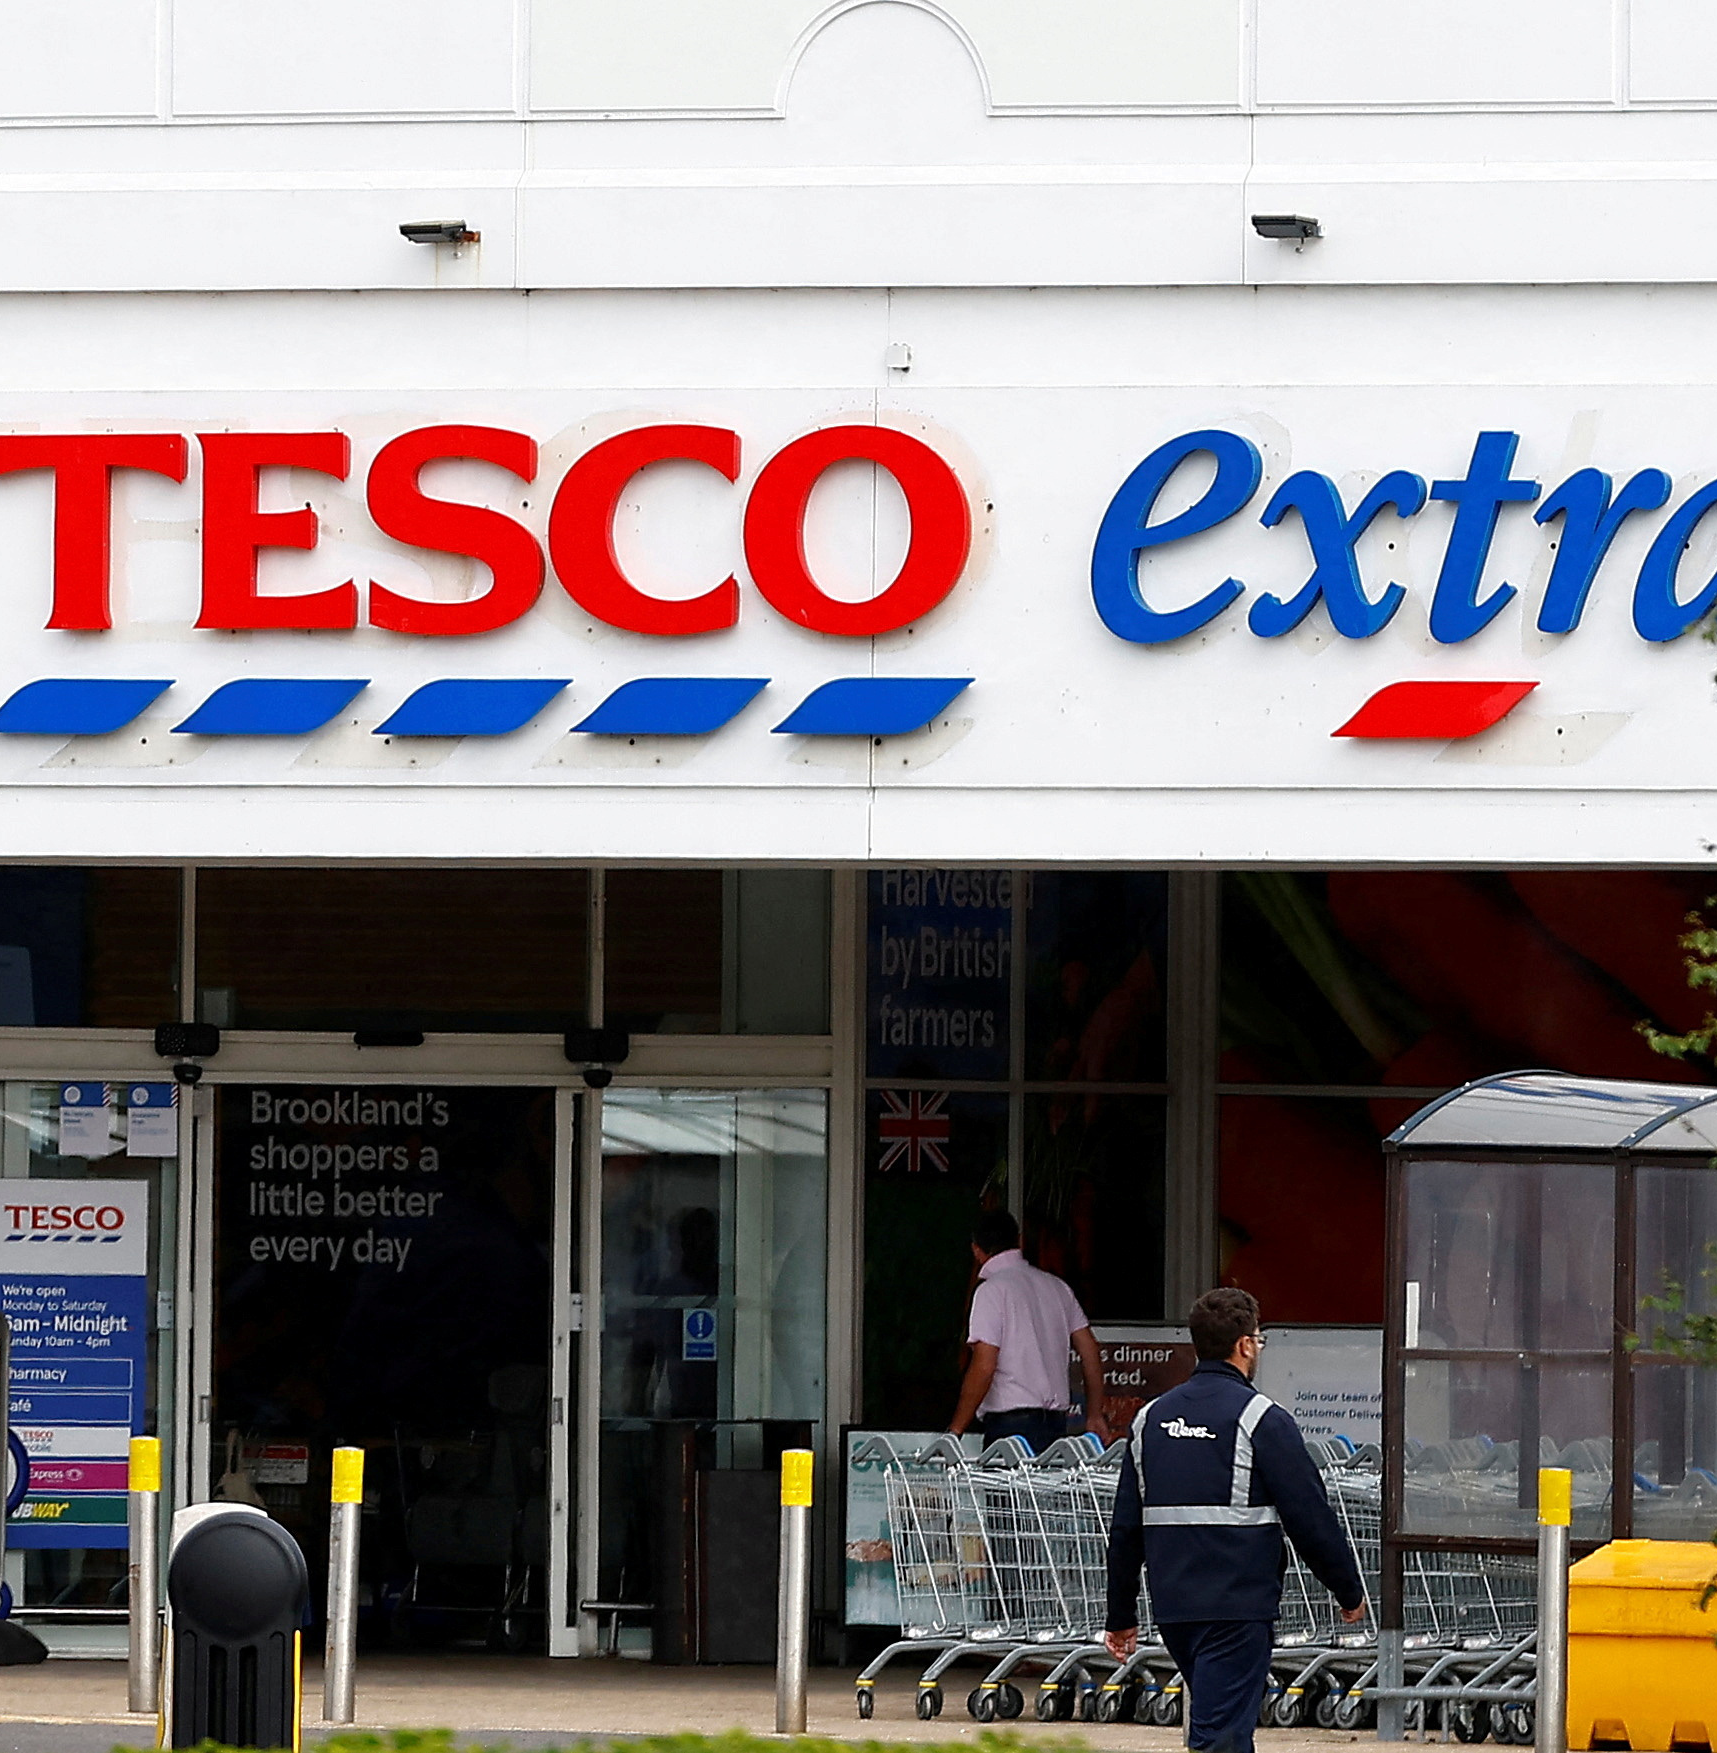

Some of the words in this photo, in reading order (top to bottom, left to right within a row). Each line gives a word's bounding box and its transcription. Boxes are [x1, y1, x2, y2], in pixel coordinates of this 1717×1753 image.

[881, 925, 915, 989] by
[921, 926, 1011, 978] British
[880, 994, 995, 1048] farmers
[249, 1135, 409, 1179] shoppers
[418, 1146, 439, 1172] a
[249, 1181, 325, 1217] little
[333, 1182, 444, 1217] better
[3, 1204, 125, 1230] TESCO
[249, 1236, 345, 1271] every
[352, 1227, 412, 1273] day
[1, 1284, 33, 1296] We're
[36, 1287, 66, 1298] open
[1, 1299, 44, 1313] Monday
[47, 1301, 59, 1311] to
[62, 1299, 107, 1313] Saturday
[54, 1314, 128, 1335] Midnight
[10, 1336, 42, 1349] unday
[45, 1336, 74, 1347] 10am
[85, 1336, 111, 1349] 4pm
[1113, 1346, 1174, 1363] dinner
[9, 1367, 67, 1383] harmacy
[1102, 1369, 1147, 1386] rted.
[9, 1399, 32, 1412] afé
[1295, 1391, 1318, 1402] Join
[1320, 1393, 1338, 1402] our
[1342, 1393, 1369, 1402] team
[1370, 1393, 1383, 1403] of
[1294, 1407, 1346, 1418] Customer
[1349, 1409, 1383, 1420] Delive
[1300, 1425, 1335, 1435] rivers.
